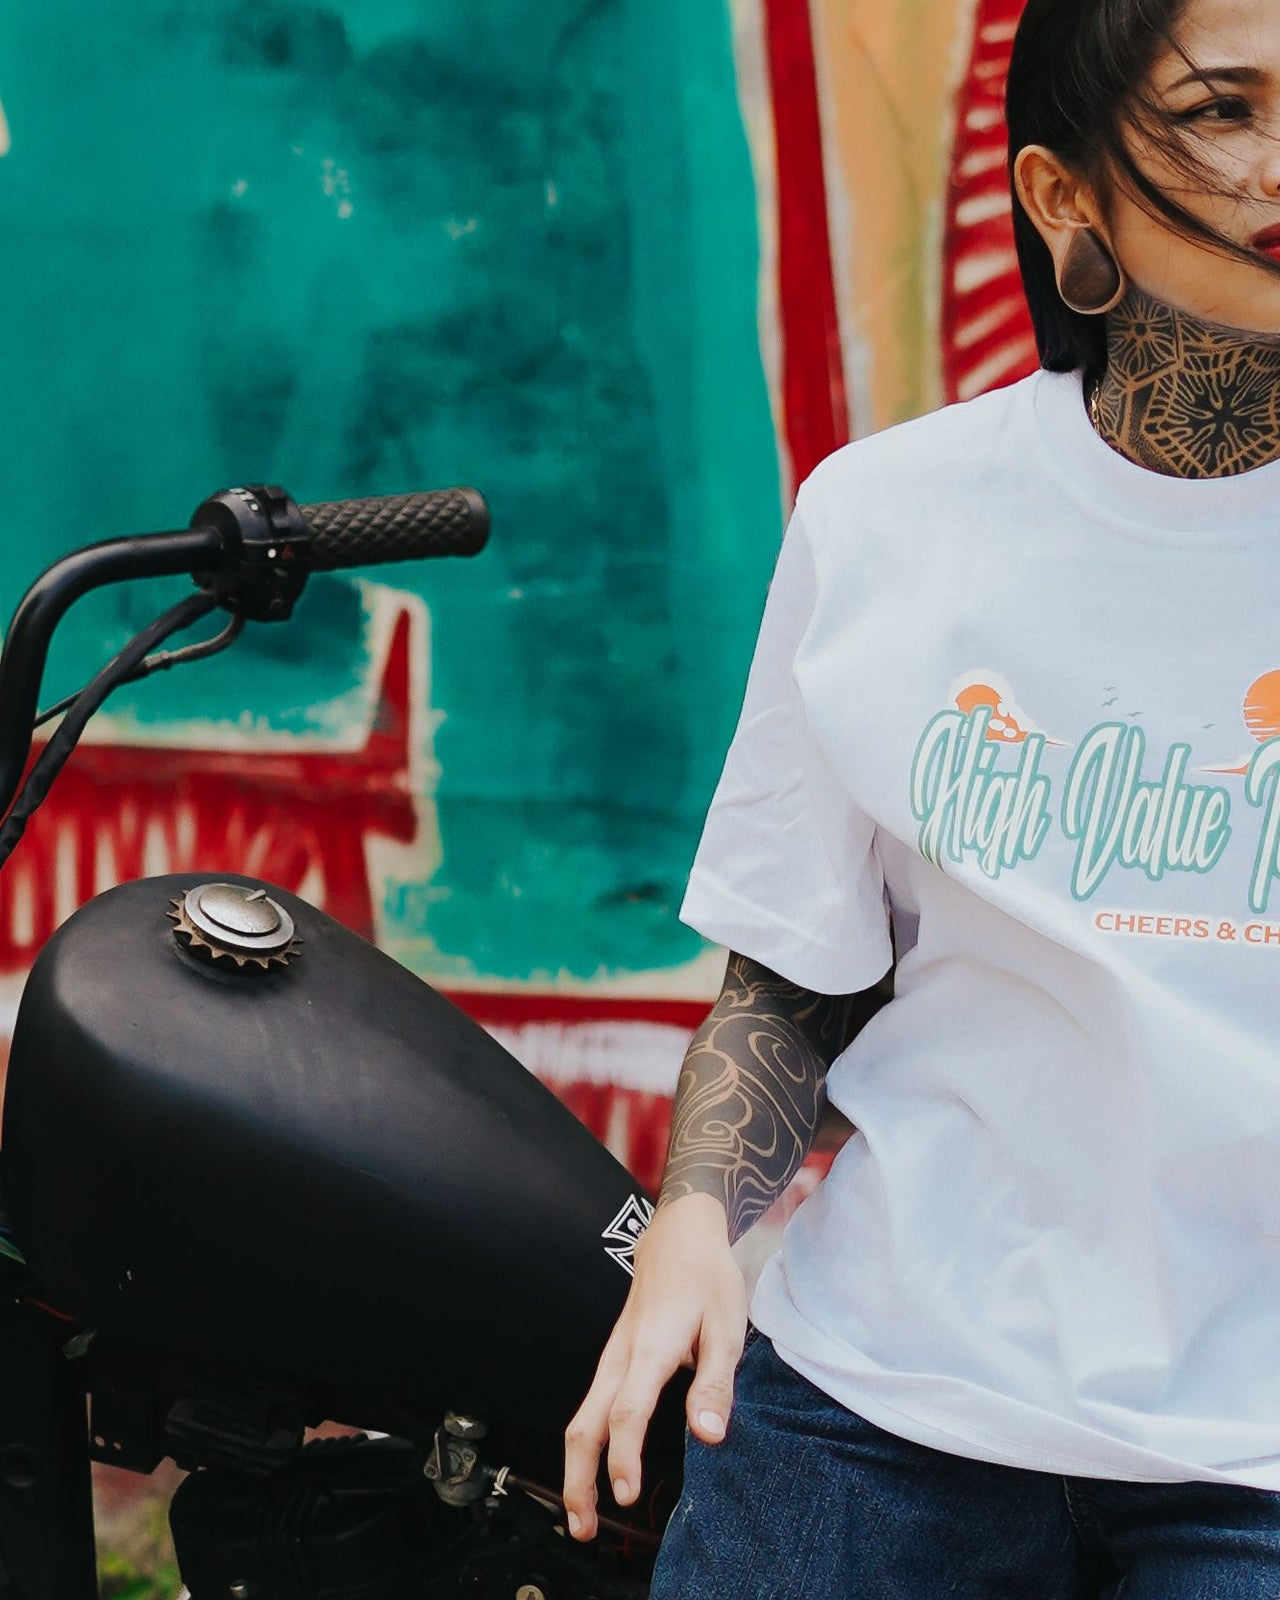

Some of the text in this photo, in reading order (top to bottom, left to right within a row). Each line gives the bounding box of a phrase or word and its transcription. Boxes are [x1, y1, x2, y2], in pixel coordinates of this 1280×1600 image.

[911, 704, 1051, 878] High
[1062, 721, 1231, 900] Value
[1094, 912, 1210, 938] CHEERS
[1216, 921, 1236, 941] &
